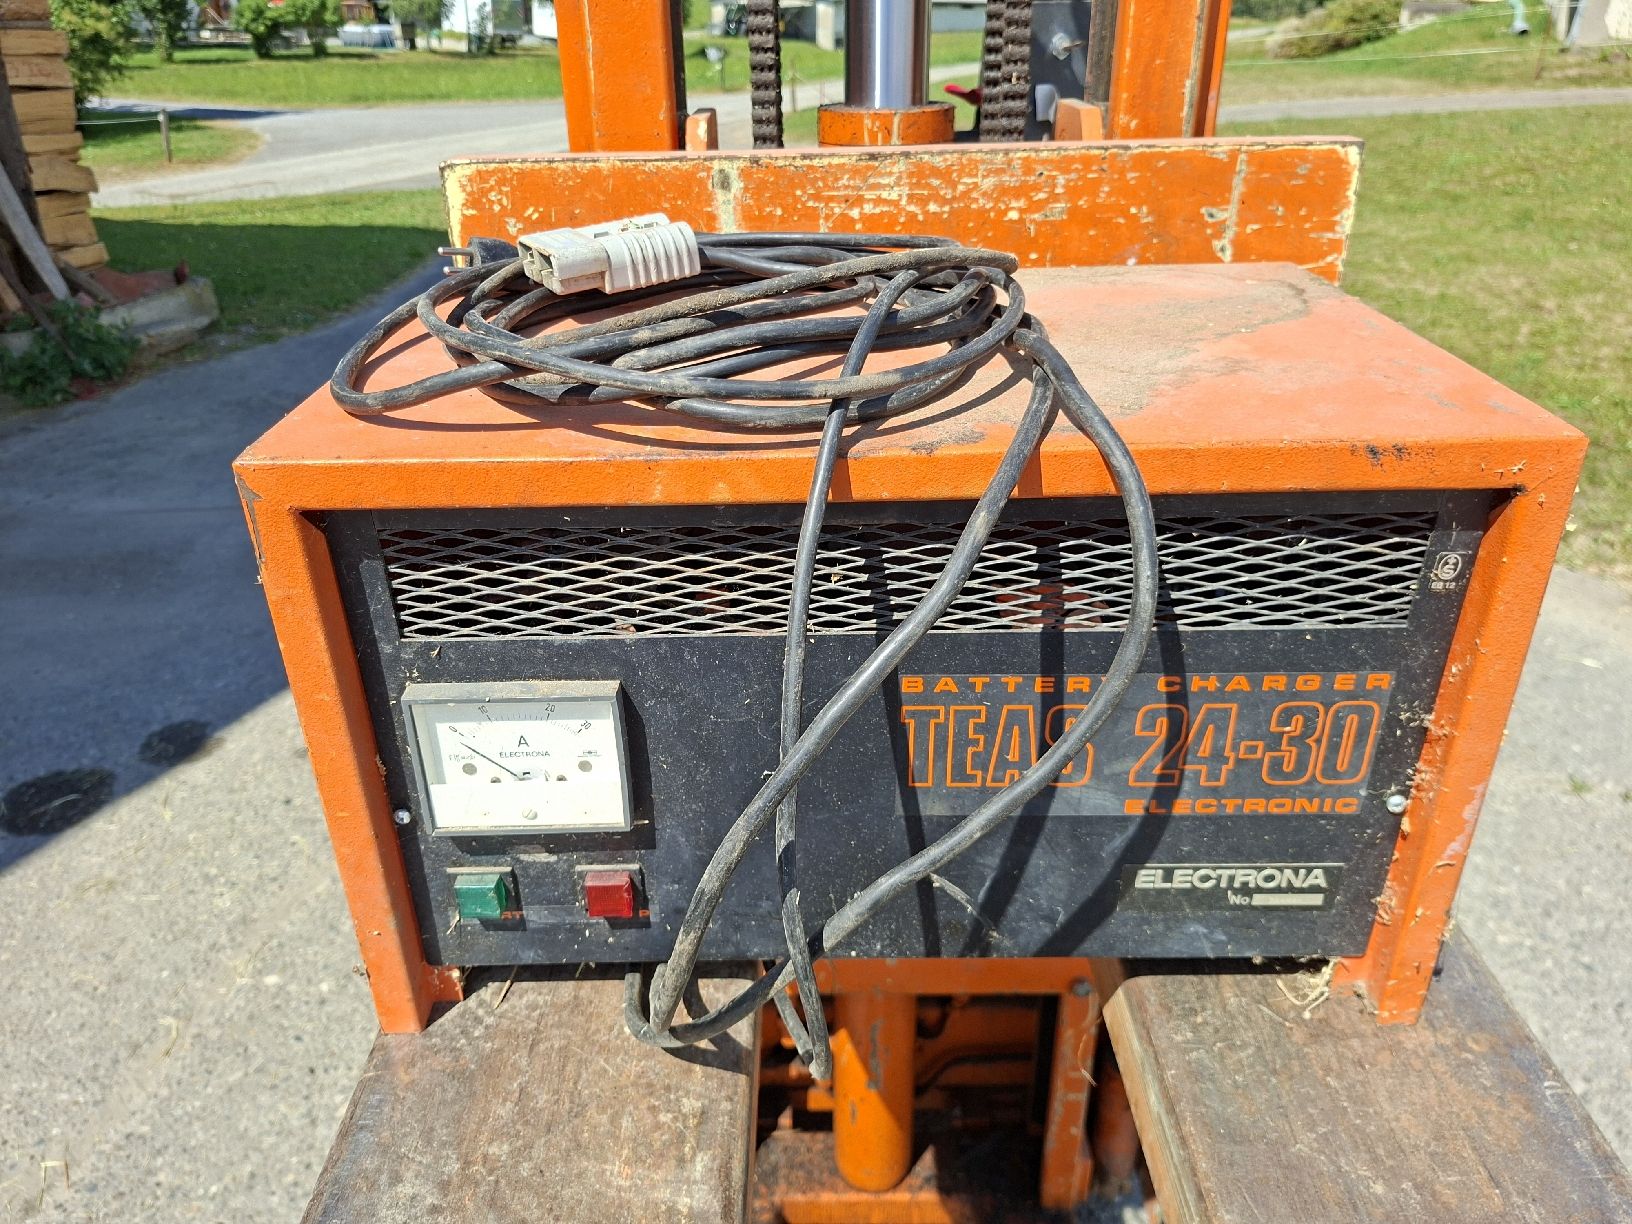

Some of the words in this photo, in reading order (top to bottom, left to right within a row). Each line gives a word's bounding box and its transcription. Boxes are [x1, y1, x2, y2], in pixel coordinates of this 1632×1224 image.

[1445, 581, 1456, 589] 12
[901, 676, 1107, 693] BATTER
[1157, 673, 1393, 692] CHARGER
[478, 705, 488, 714] 10
[545, 703, 556, 713] 20
[449, 725, 458, 733] 0
[581, 720, 592, 730] 30
[517, 735, 530, 748] A
[1128, 700, 1381, 787] 24-30
[1124, 797, 1360, 815] ELECTRONIC
[1135, 868, 1328, 889] ELECTRONA
